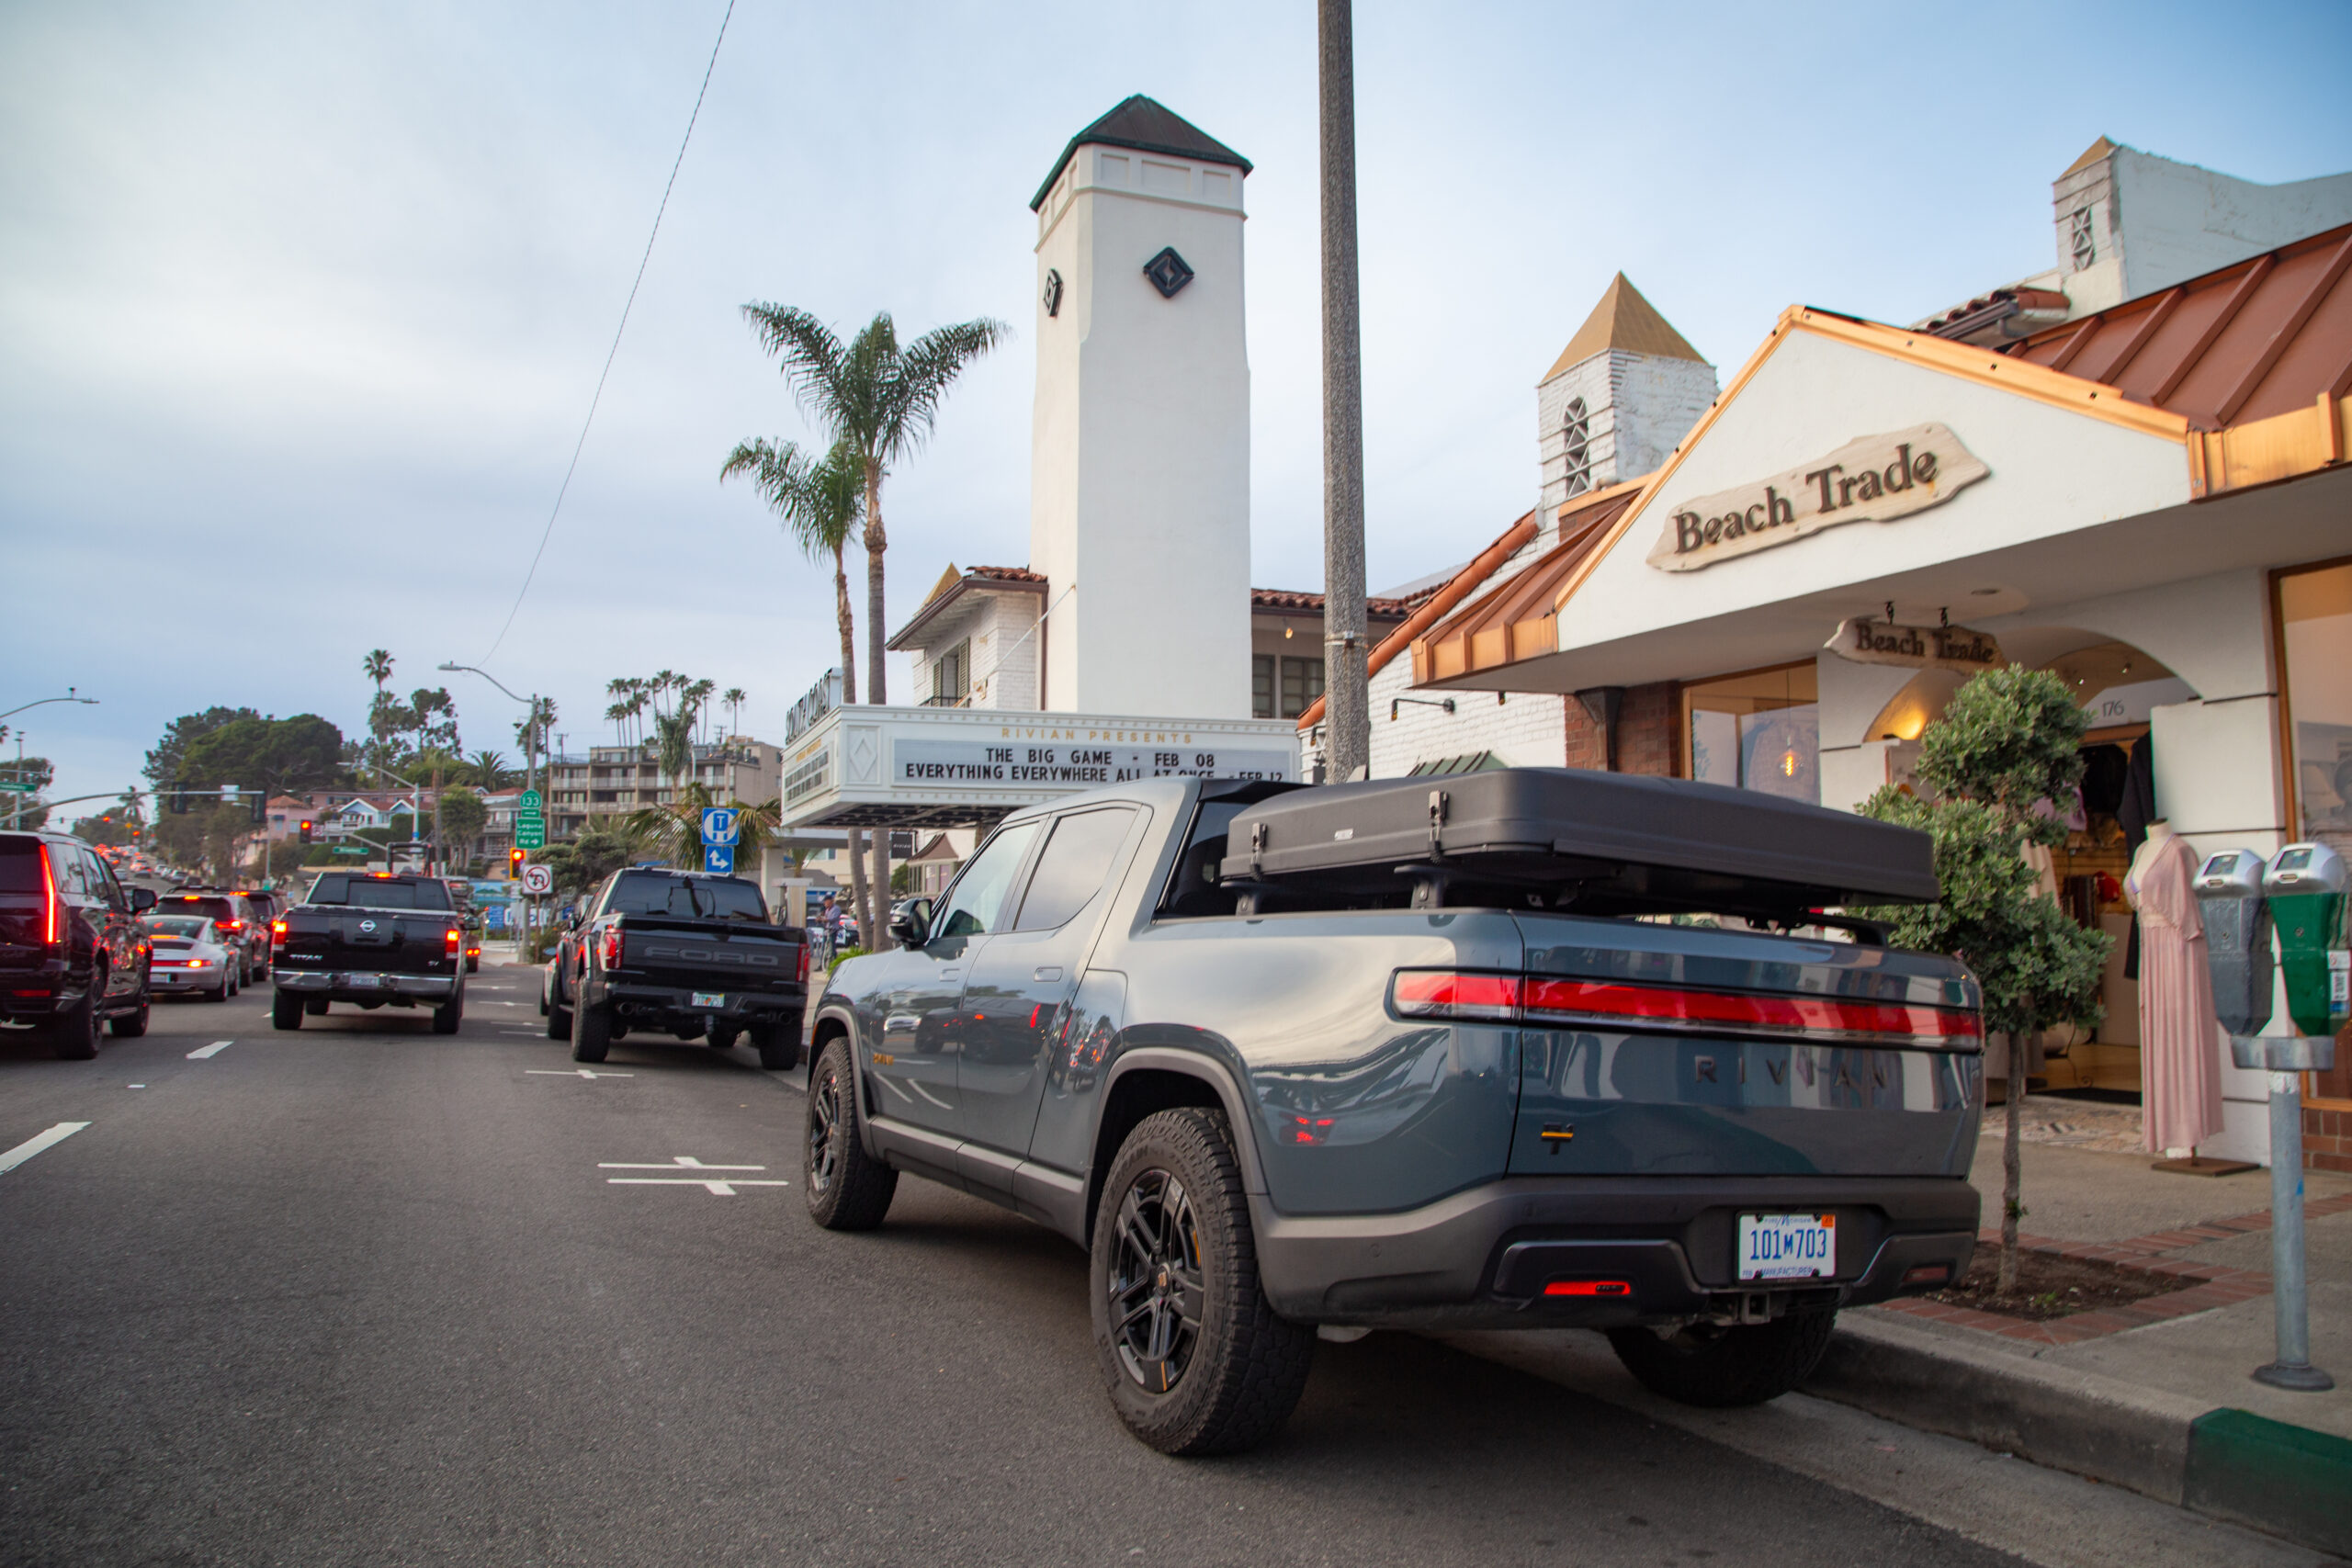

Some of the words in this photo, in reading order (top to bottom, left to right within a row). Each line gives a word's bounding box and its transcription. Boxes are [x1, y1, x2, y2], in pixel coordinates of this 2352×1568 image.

[1672, 485, 1793, 555] Beach
[1805, 442, 1938, 514] Trade
[1856, 623, 1925, 658] Beach
[1930, 630, 1995, 662] Trade
[2102, 699, 2125, 717] 176
[1002, 727, 1074, 740] RIVIAN
[1089, 730, 1192, 744] PRESENTS
[986, 748, 1013, 762] THE
[1028, 749, 1054, 763] BIG
[1070, 750, 1113, 765] GAME
[1155, 753, 1180, 767] FEB
[1195, 753, 1215, 768] 08
[906, 763, 1003, 779] EVERYTHING
[1012, 766, 1108, 782] EVERYWHERE
[1116, 768, 1139, 782] ALL
[522, 796, 539, 807] 133
[289, 953, 323, 962] TITAN
[644, 946, 779, 965] FORD
[1695, 1055, 1887, 1089] RIVIAN
[1750, 1229, 1826, 1260] 101M703
